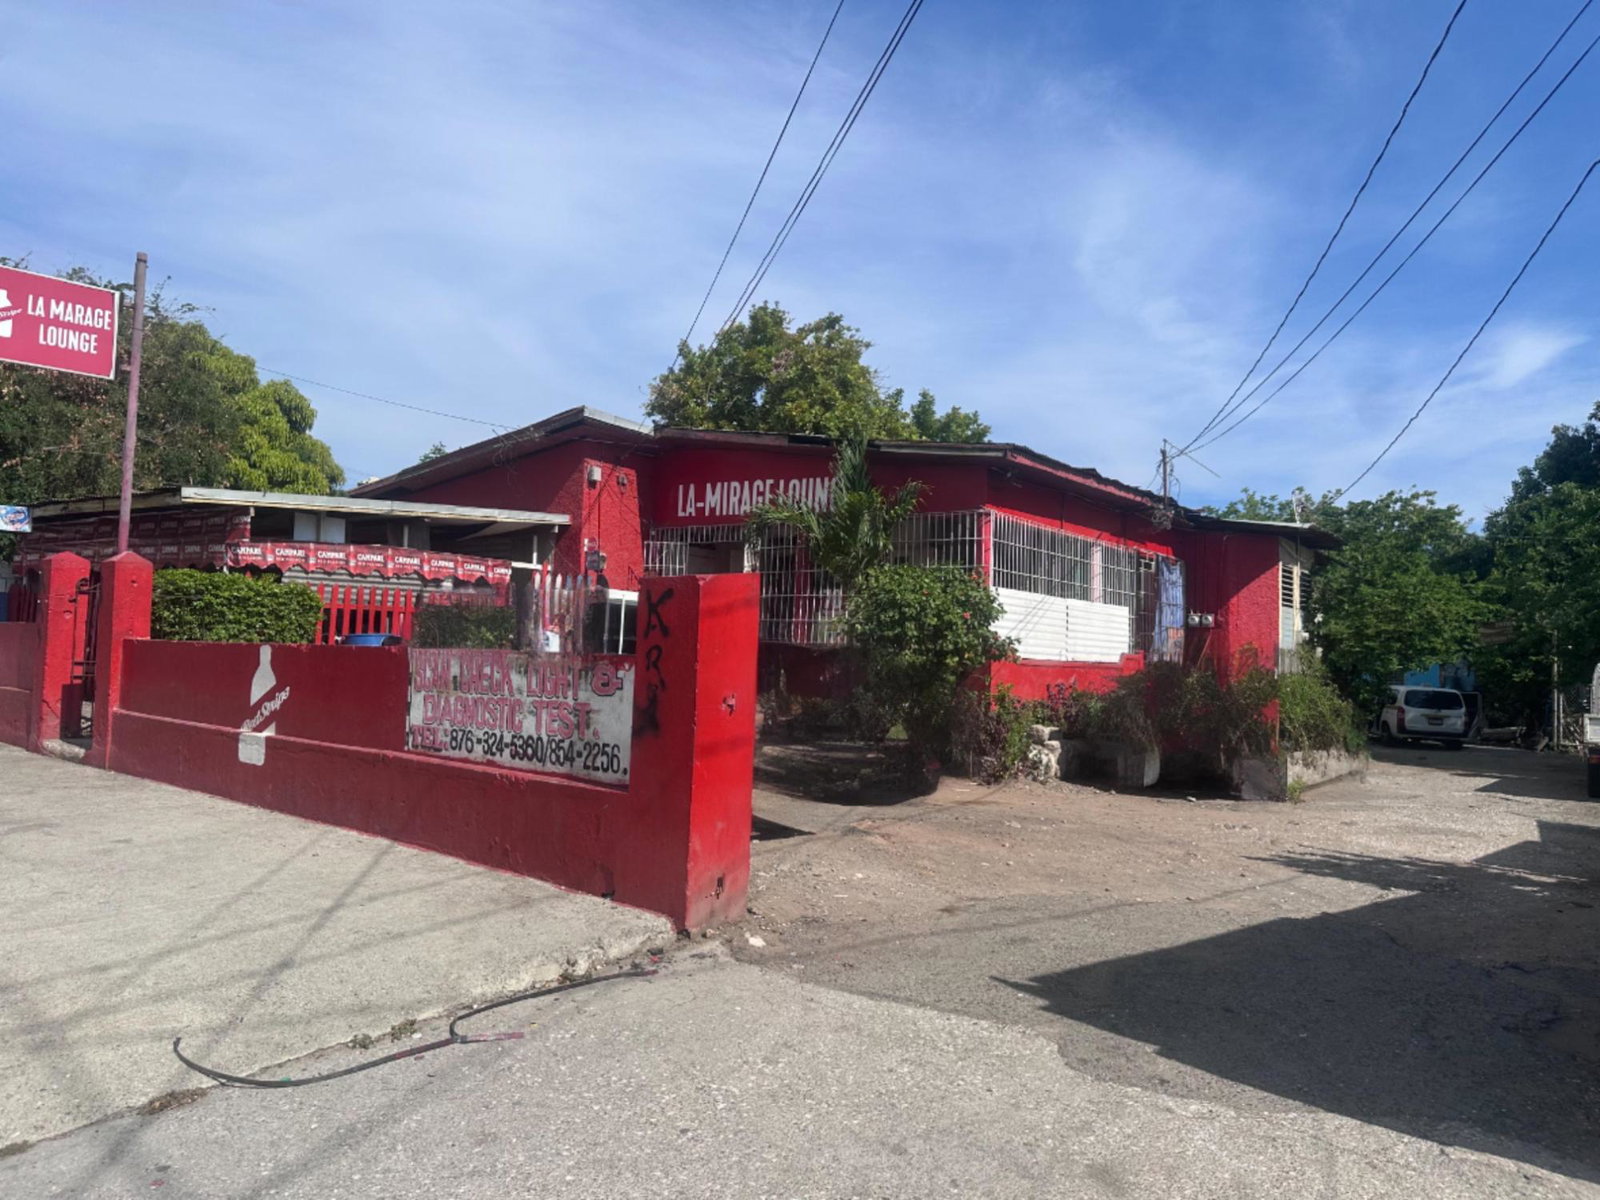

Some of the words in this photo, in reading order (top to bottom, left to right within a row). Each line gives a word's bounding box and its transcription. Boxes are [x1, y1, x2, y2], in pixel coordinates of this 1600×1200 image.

[27, 294, 46, 318] LA
[49, 298, 112, 331] MARAGE
[38, 323, 99, 355] LOUNGE
[590, 662, 624, 697] &
